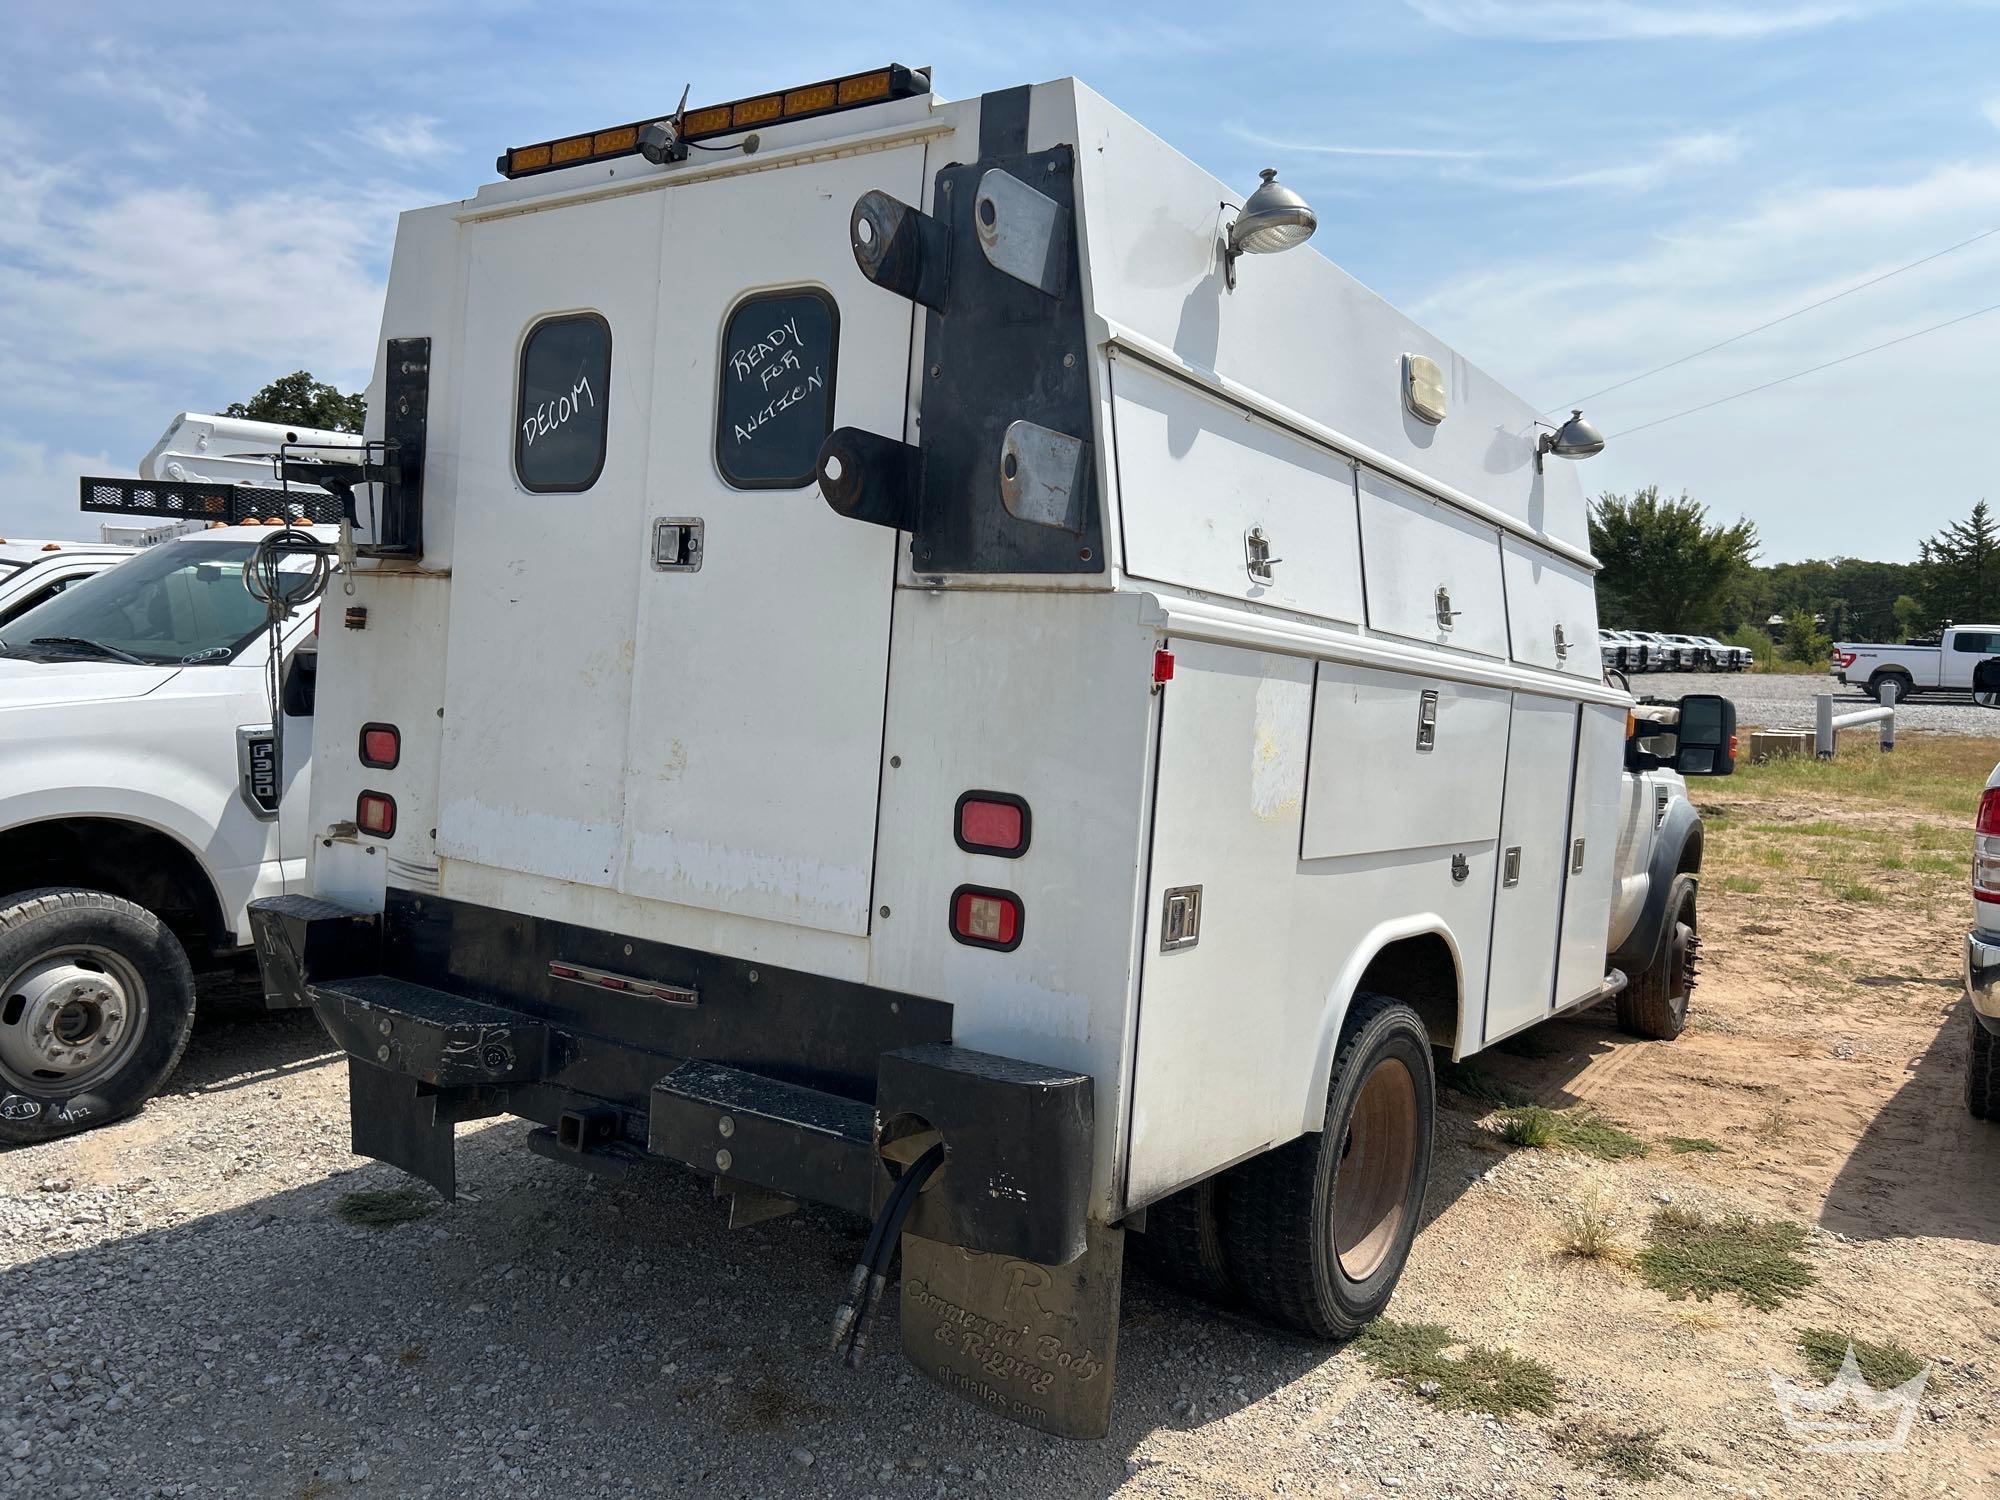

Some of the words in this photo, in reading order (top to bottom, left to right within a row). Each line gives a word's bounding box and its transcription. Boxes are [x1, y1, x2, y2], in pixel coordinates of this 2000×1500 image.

[729, 317, 804, 381] READY
[760, 350, 800, 391] FOR
[522, 377, 594, 446] DECOM
[733, 366, 823, 444] AUCTION
[254, 743, 273, 796] F350
[906, 1279, 1030, 1347] Commercial
[1038, 1335, 1104, 1382] Body
[934, 1321, 956, 1346] &
[961, 1332, 1055, 1395] Rigging
